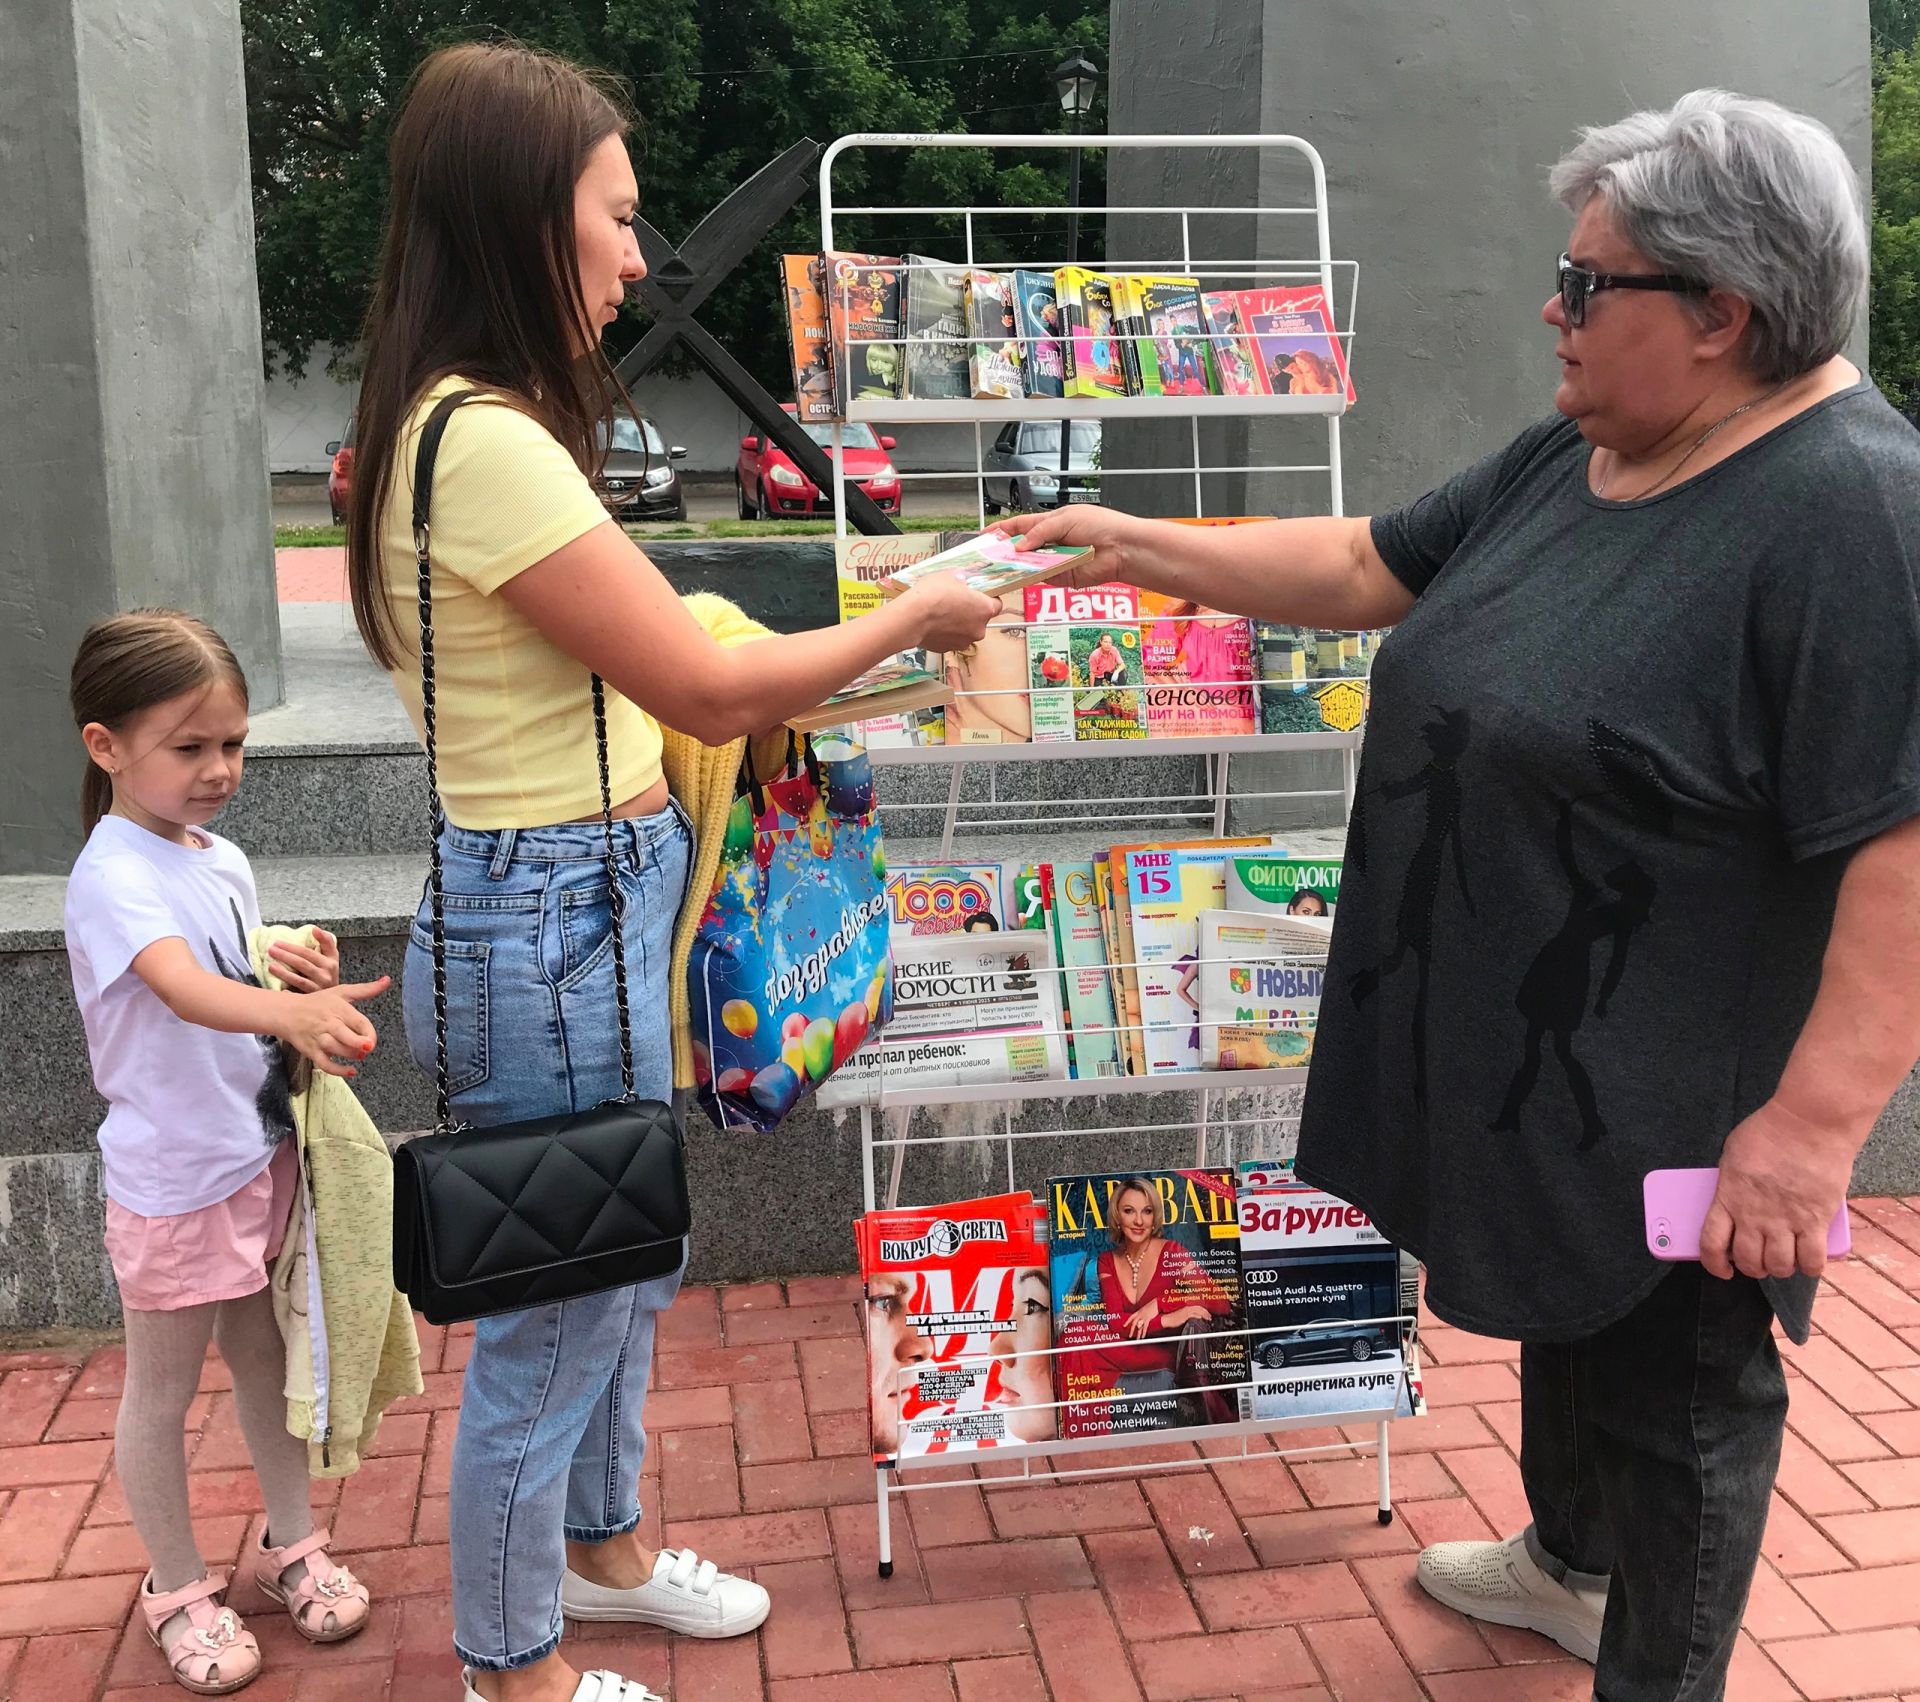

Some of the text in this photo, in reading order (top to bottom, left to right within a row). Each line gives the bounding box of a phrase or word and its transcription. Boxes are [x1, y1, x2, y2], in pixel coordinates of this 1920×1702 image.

[1036, 587, 1133, 623] Дача
[1153, 646, 1176, 655] ВАШ
[1147, 655, 1177, 663] РАЗМЕР
[1078, 719, 1092, 729] КАК
[1094, 719, 1138, 729] УХАЖИВАТЬ
[1077, 730, 1088, 739] ЗА
[1089, 730, 1120, 739] ЛЕТНИМ
[1120, 730, 1146, 739] САДОМ
[1133, 853, 1172, 868] МНЕ
[1137, 870, 1171, 894] 15
[887, 872, 992, 923] 1000
[978, 959, 993, 967] 16+
[908, 1044, 967, 1064] ребенок:
[890, 1068, 901, 1076] от
[903, 1063, 941, 1075] опытных
[942, 1058, 991, 1070] поисковиков
[882, 1234, 934, 1260] ВОКРУГ
[961, 1219, 1005, 1240] СВЕТА
[1058, 1231, 1086, 1240] историй
[1163, 1251, 1169, 1259] Я
[1162, 1260, 1189, 1268] Самое
[1189, 1259, 1225, 1267] страшное
[1161, 1268, 1238, 1277] мной уже случилось.
[1175, 1278, 1206, 1286] Кристина
[1247, 1283, 1364, 1297] Новый Audi A5 quattro
[1061, 1293, 1087, 1303] Ирина
[1167, 1295, 1200, 1303] Дмитрием
[1248, 1294, 1347, 1308] Новый эталон купе
[1062, 1302, 1107, 1312] Толмацкая:
[1063, 1313, 1121, 1323] Саша потерял
[1086, 1323, 1109, 1331] когда
[1064, 1332, 1121, 1344] создал Децла
[1210, 1351, 1245, 1360] Шрайбер:
[1195, 1361, 1245, 1370] Как обмануть
[923, 1368, 987, 1377] МЕКСИКАНСКИЕ
[1221, 1369, 1246, 1378] судьбу
[944, 1375, 973, 1383] СИГАРА
[1066, 1373, 1101, 1386] Елена
[1358, 1373, 1394, 1391] купе
[1068, 1387, 1126, 1401] Яковлева:
[1069, 1399, 1177, 1418] Мы снова думаем
[968, 1414, 1004, 1423] ГЛАВНАЯ
[1069, 1417, 1167, 1433] о пополнении...
